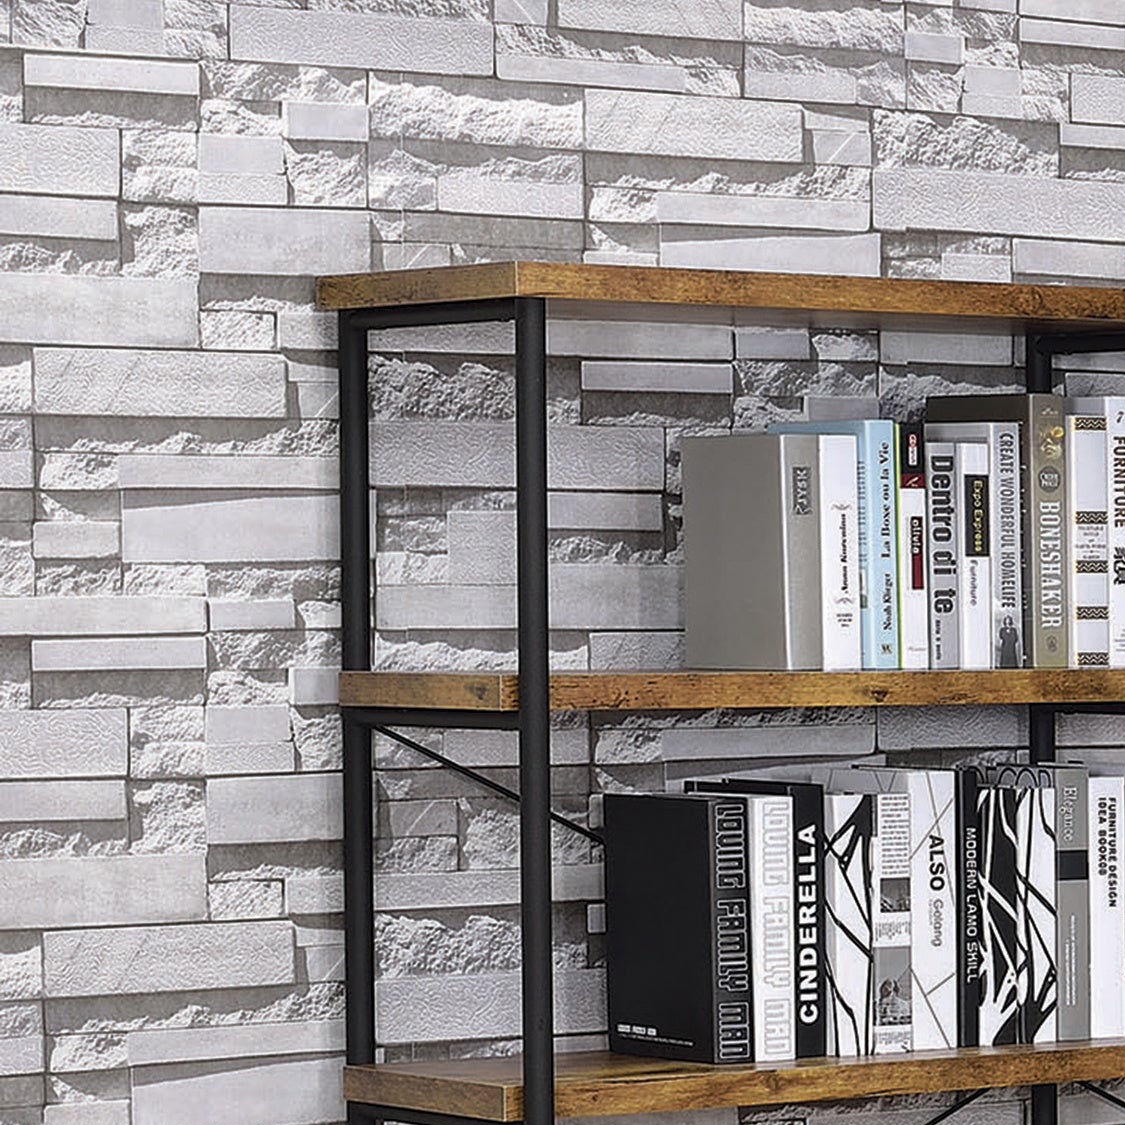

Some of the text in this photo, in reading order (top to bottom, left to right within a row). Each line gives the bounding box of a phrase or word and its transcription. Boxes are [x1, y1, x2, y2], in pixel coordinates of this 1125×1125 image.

[878, 442, 891, 558] La Boxe ou la Vie
[911, 518, 921, 554] olivia
[931, 455, 957, 614] Dentro di te
[972, 480, 984, 552] Expo Express
[999, 432, 1016, 608] CREATE WONDERFUL HOMELIFE
[969, 559, 978, 607] Furniture
[1039, 501, 1062, 629] BONESHAKER
[882, 605, 893, 631] Noah
[1060, 786, 1078, 842] Elegance
[1097, 797, 1107, 825] IDEA
[928, 834, 946, 891] ALSO
[1107, 797, 1117, 908] FURNITURE DESIGN
[798, 824, 819, 1024] CINDERELLA
[931, 899, 945, 948] Golang
[965, 827, 978, 983] MODERN LAMO SKILL
